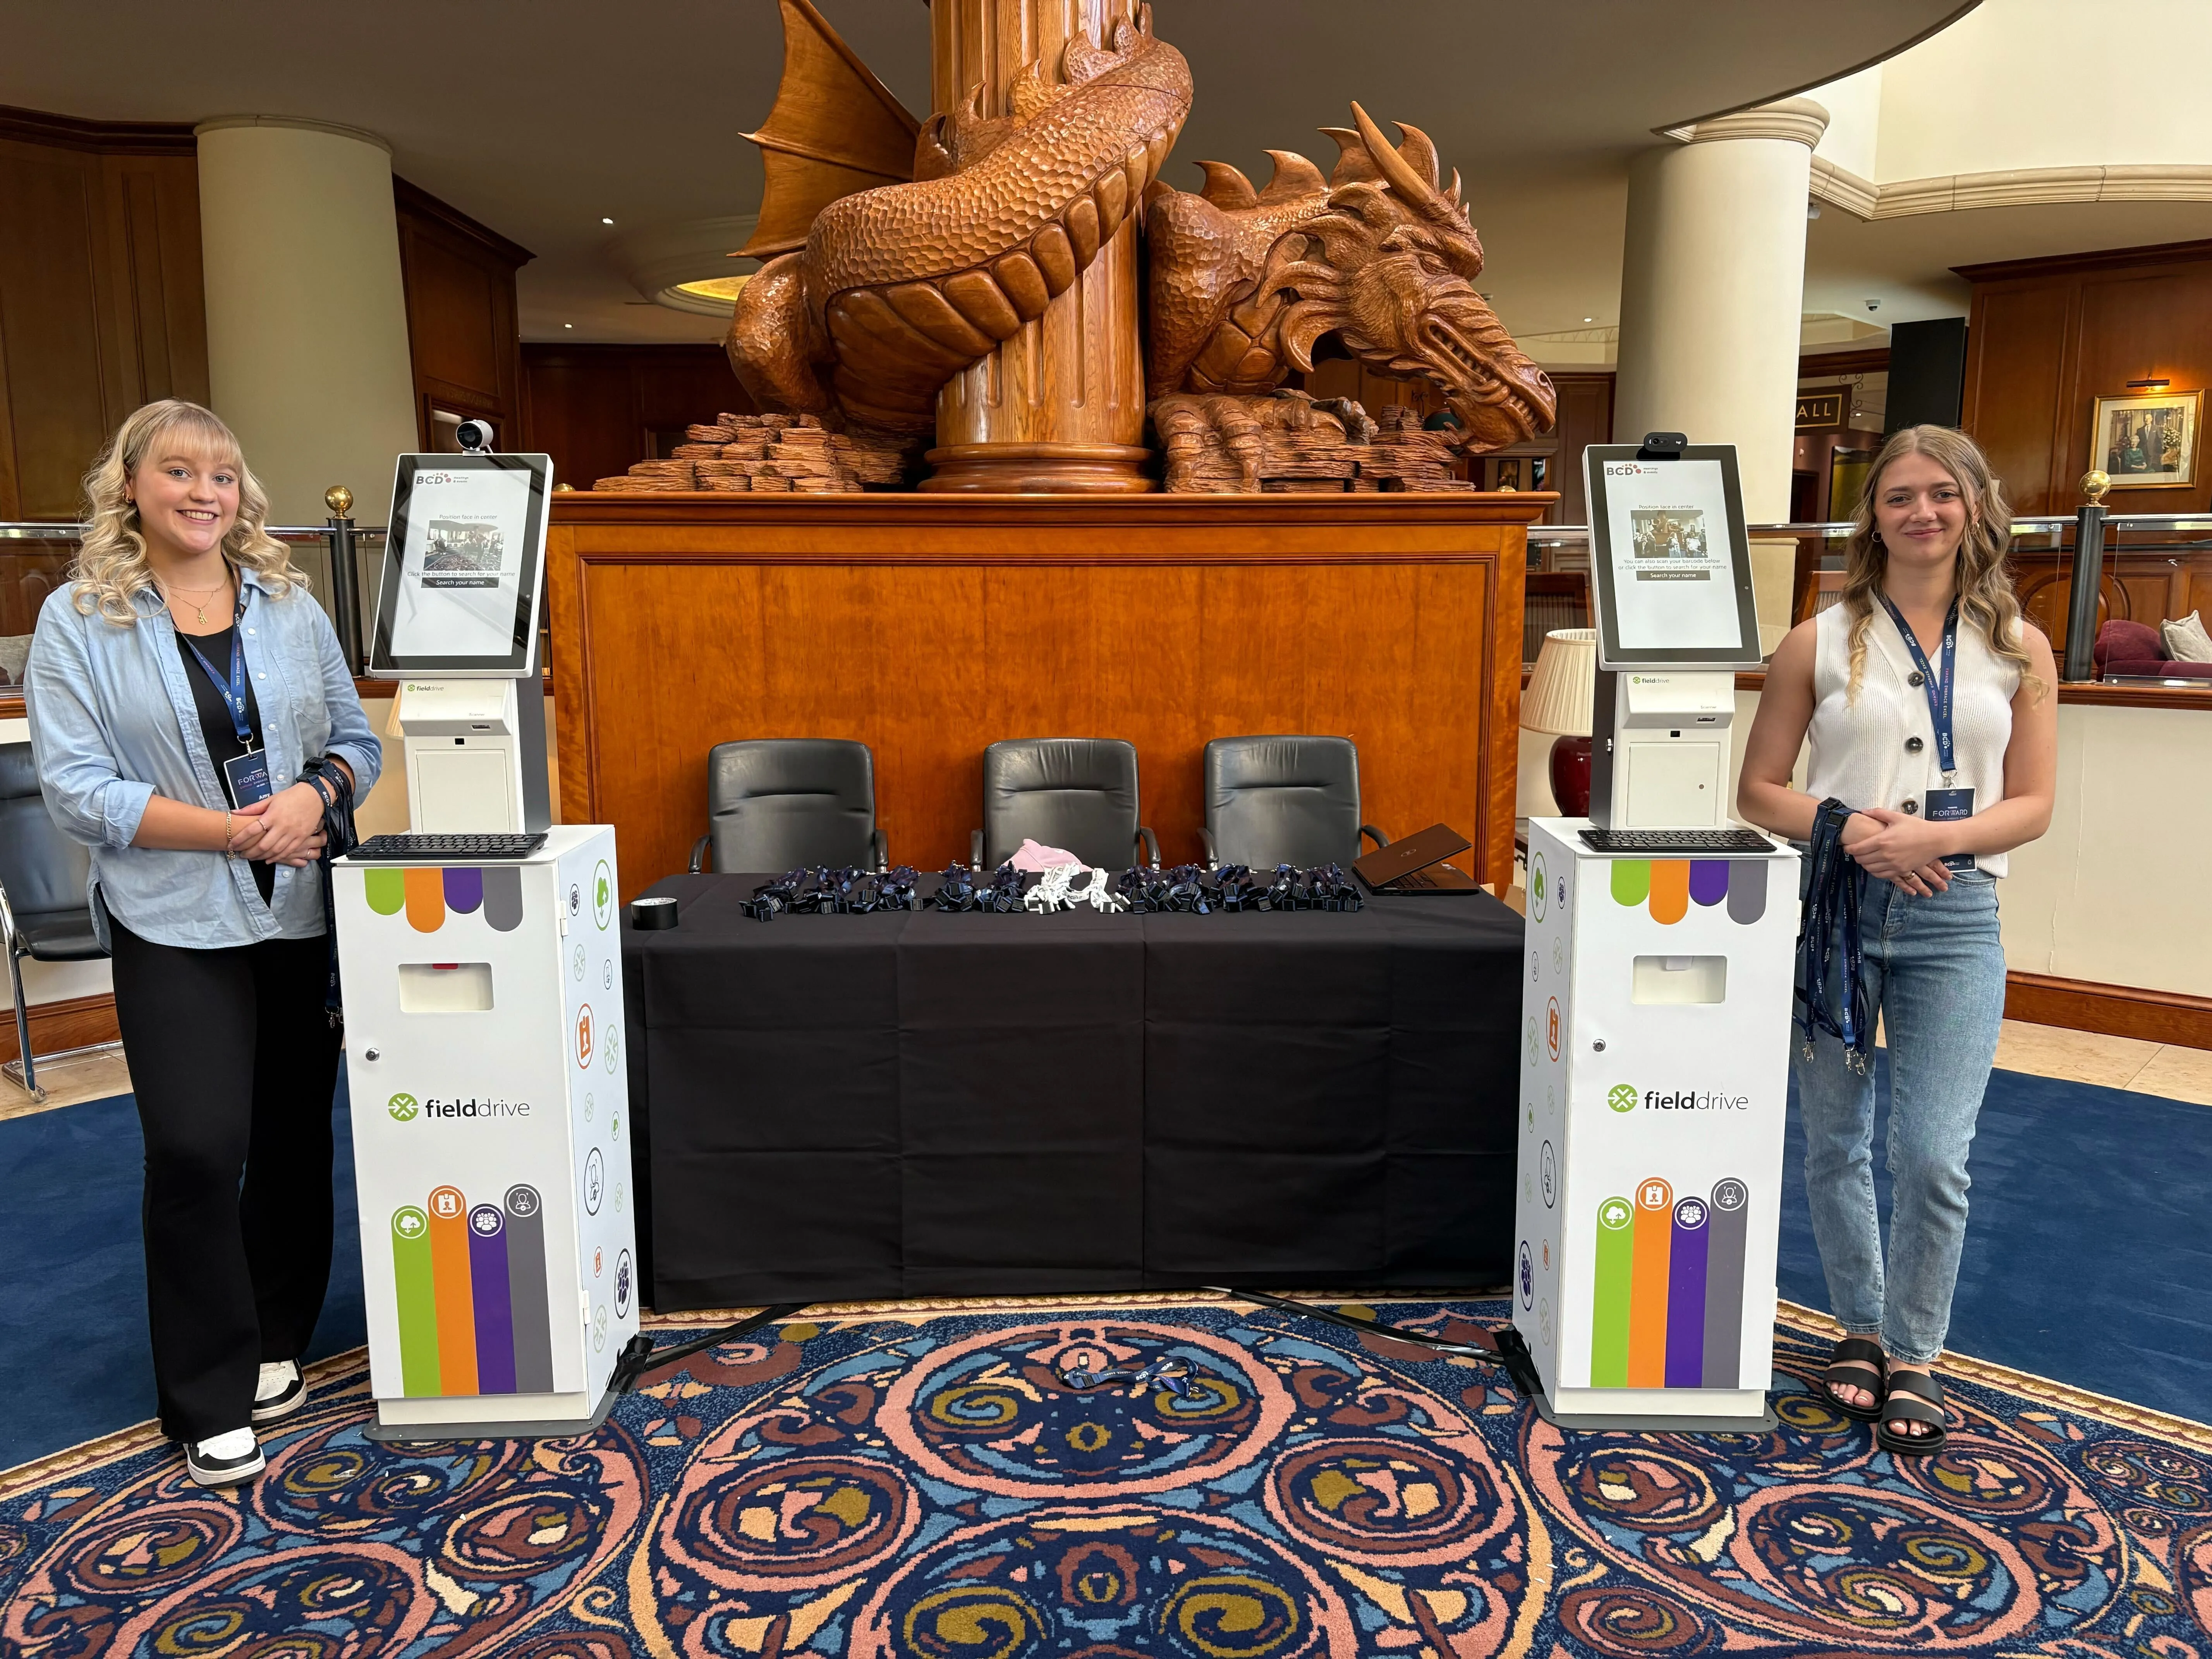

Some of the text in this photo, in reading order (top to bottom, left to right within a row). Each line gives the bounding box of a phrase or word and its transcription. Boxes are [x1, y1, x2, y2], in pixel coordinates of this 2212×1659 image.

[1796, 402, 1831, 418] ALL
[1607, 467, 1633, 476] BCD
[416, 476, 443, 484] BCD
[1908, 636, 1916, 646] BCD
[238, 771, 268, 785] FORWA
[1645, 1091, 1748, 1110] fielddrive
[425, 1098, 530, 1118] fielddrive
[1136, 1372, 1147, 1381] BCD
